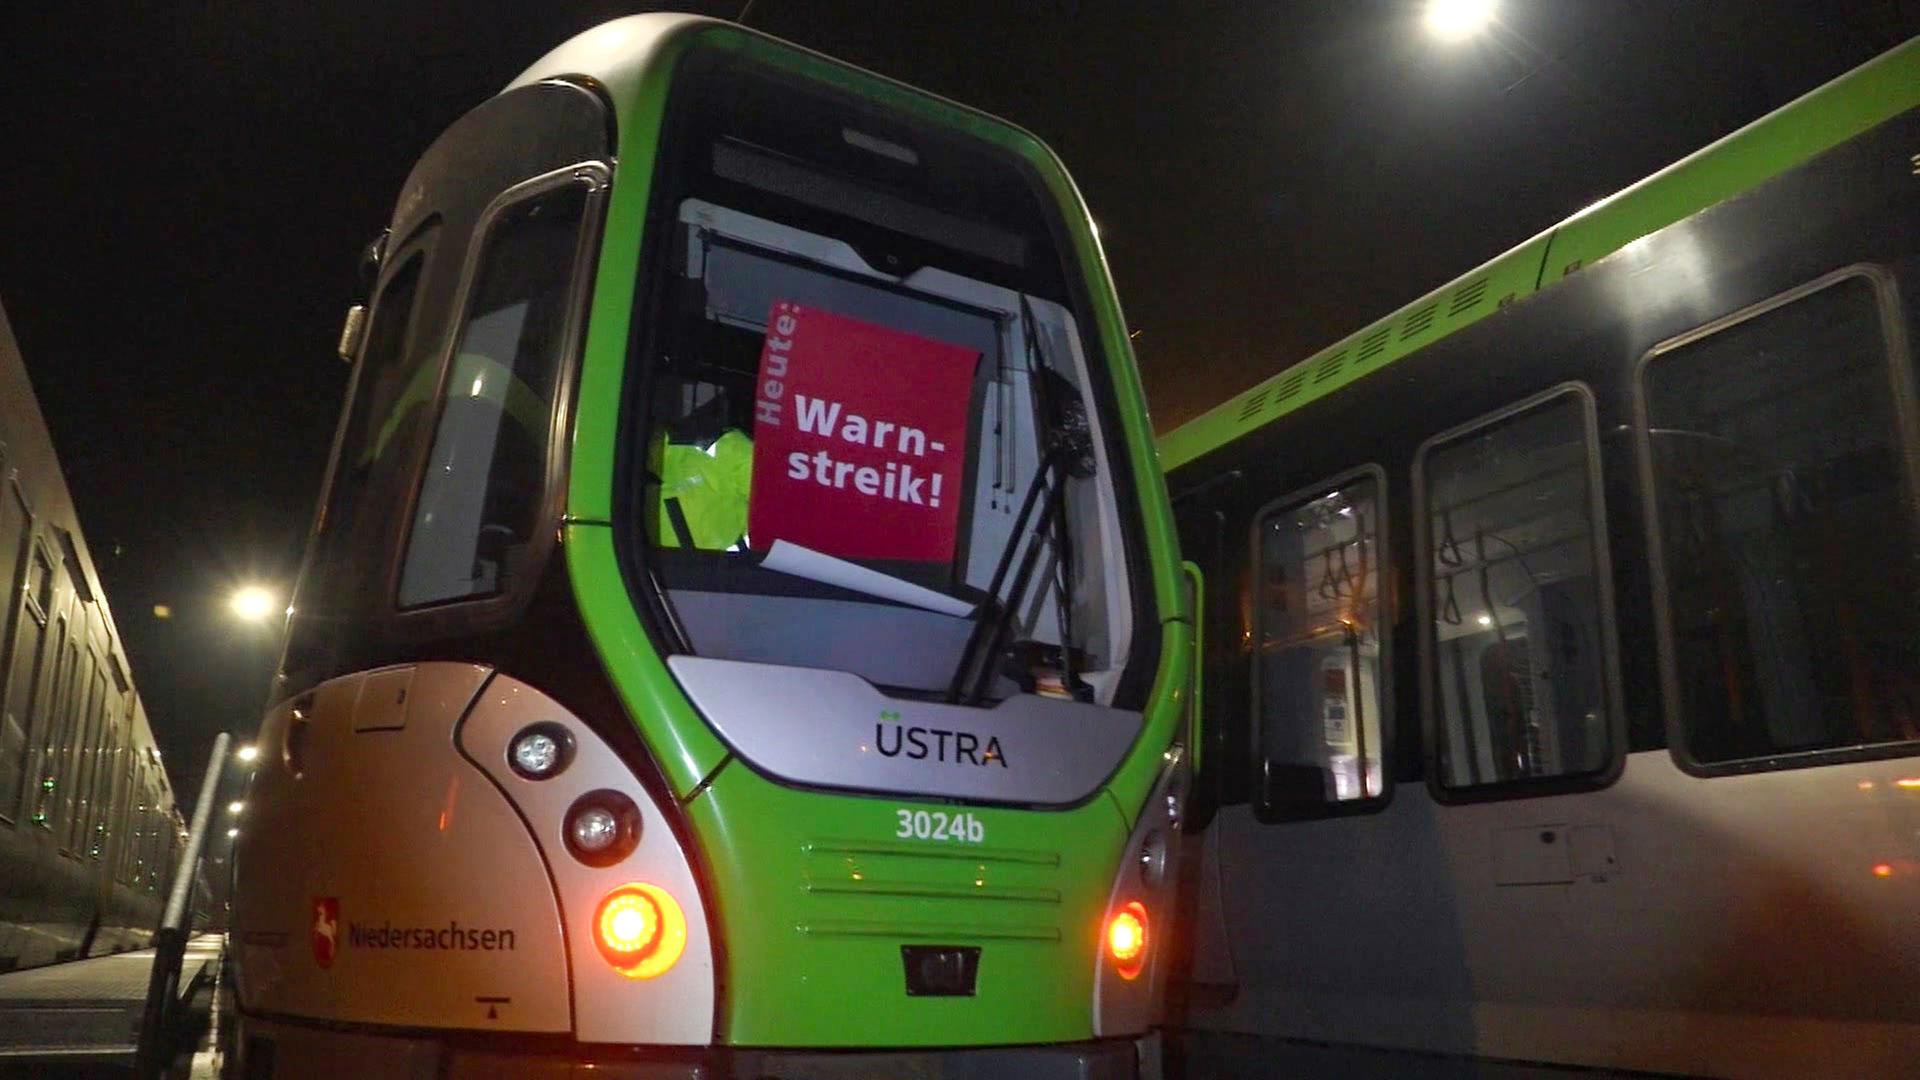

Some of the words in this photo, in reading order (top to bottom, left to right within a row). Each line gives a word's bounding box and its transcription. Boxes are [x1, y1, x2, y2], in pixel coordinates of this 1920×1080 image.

[756, 303, 800, 425] Heute:
[795, 394, 945, 456] Warn-
[788, 450, 943, 508] streik!
[875, 712, 1007, 768] ÜSTRA
[897, 809, 984, 843] 3024b
[350, 920, 514, 951] Niedersachsen
